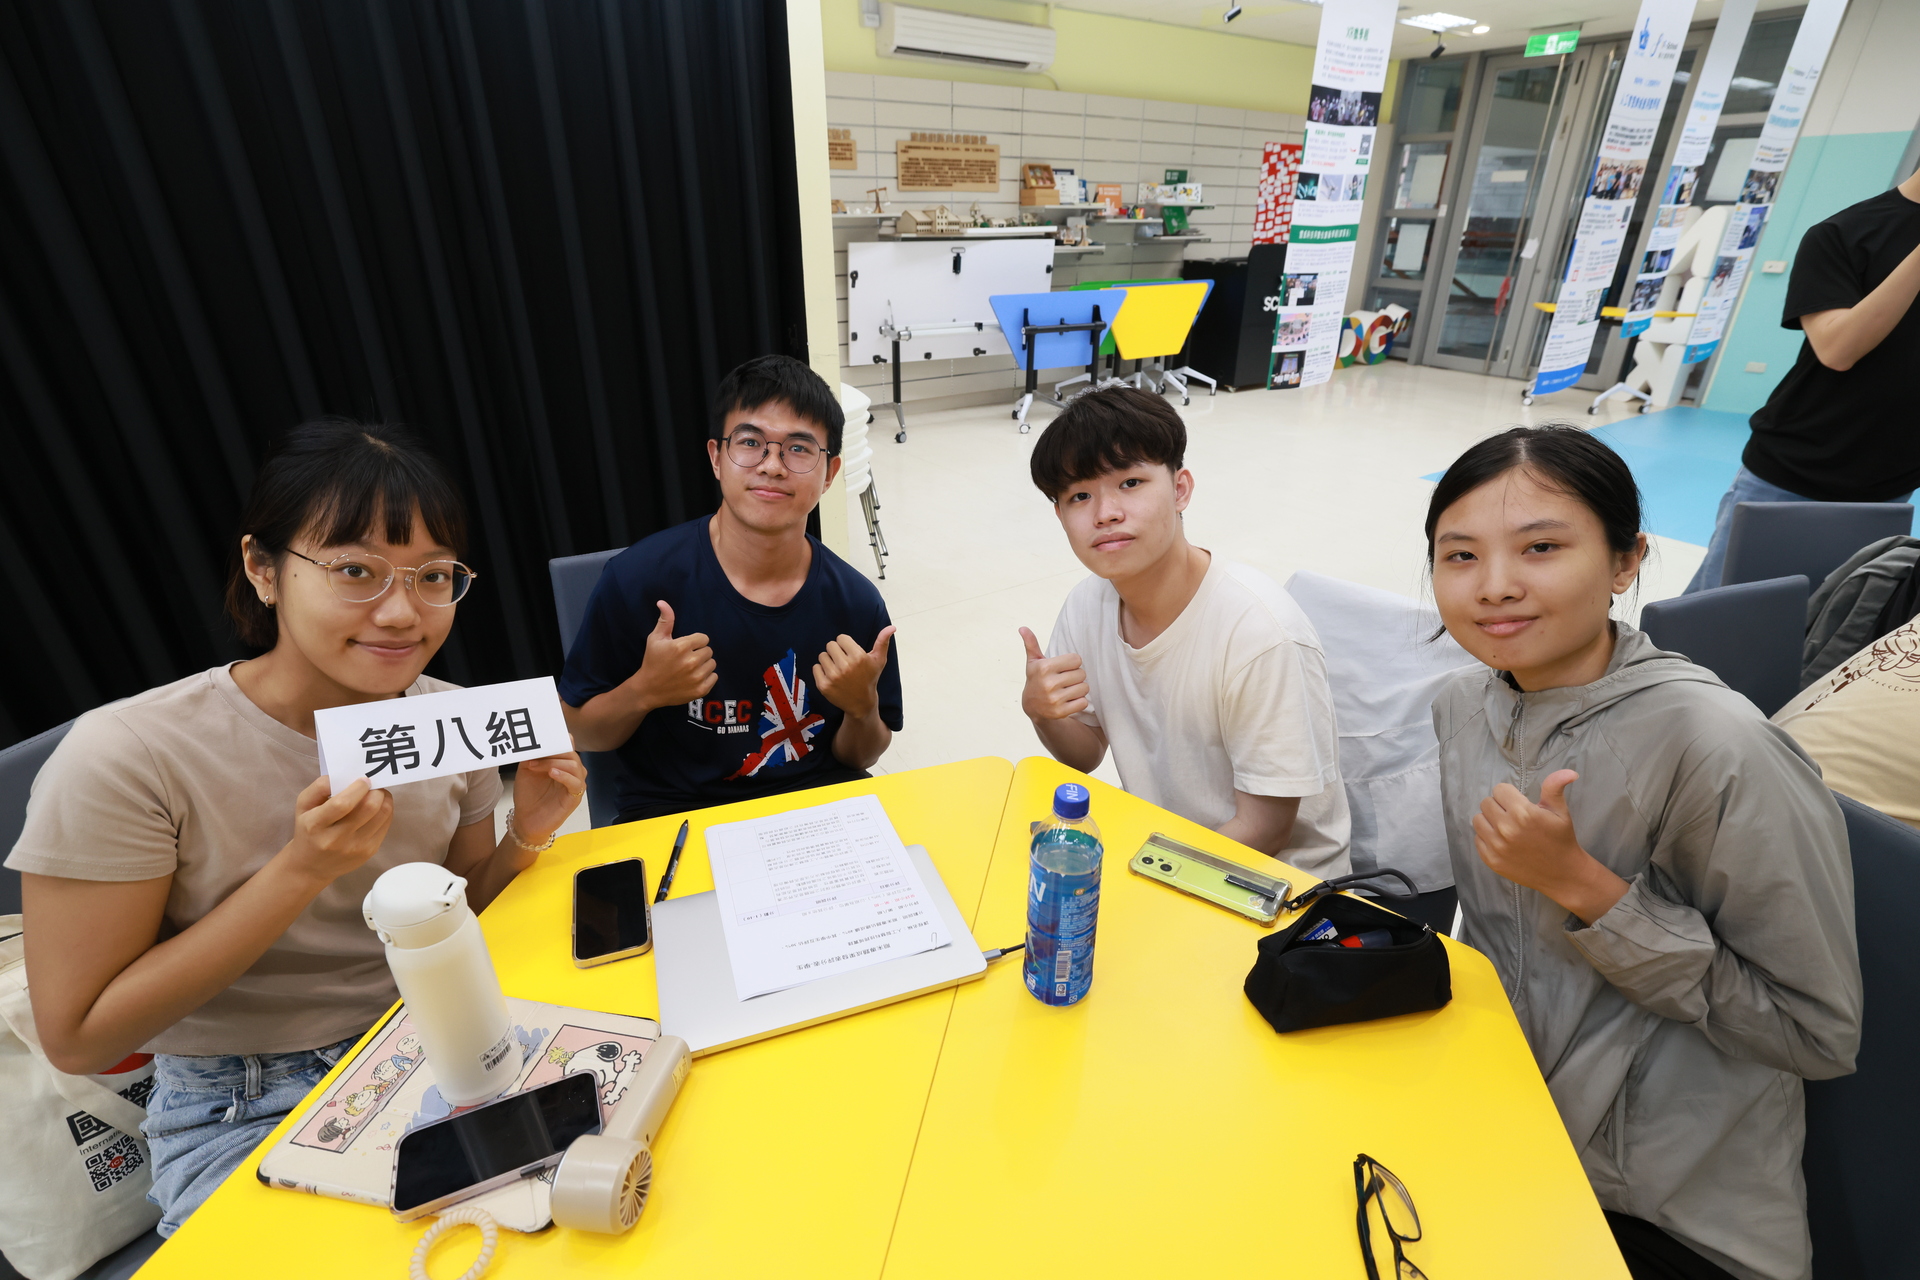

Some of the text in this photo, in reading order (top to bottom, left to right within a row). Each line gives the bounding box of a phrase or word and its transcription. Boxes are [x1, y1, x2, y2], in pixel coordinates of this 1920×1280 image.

[688, 698, 752, 725] HCEC
[717, 725, 750, 734] GO BANANAS
[358, 707, 541, 778] 第八組
[1065, 783, 1079, 801] FIN
